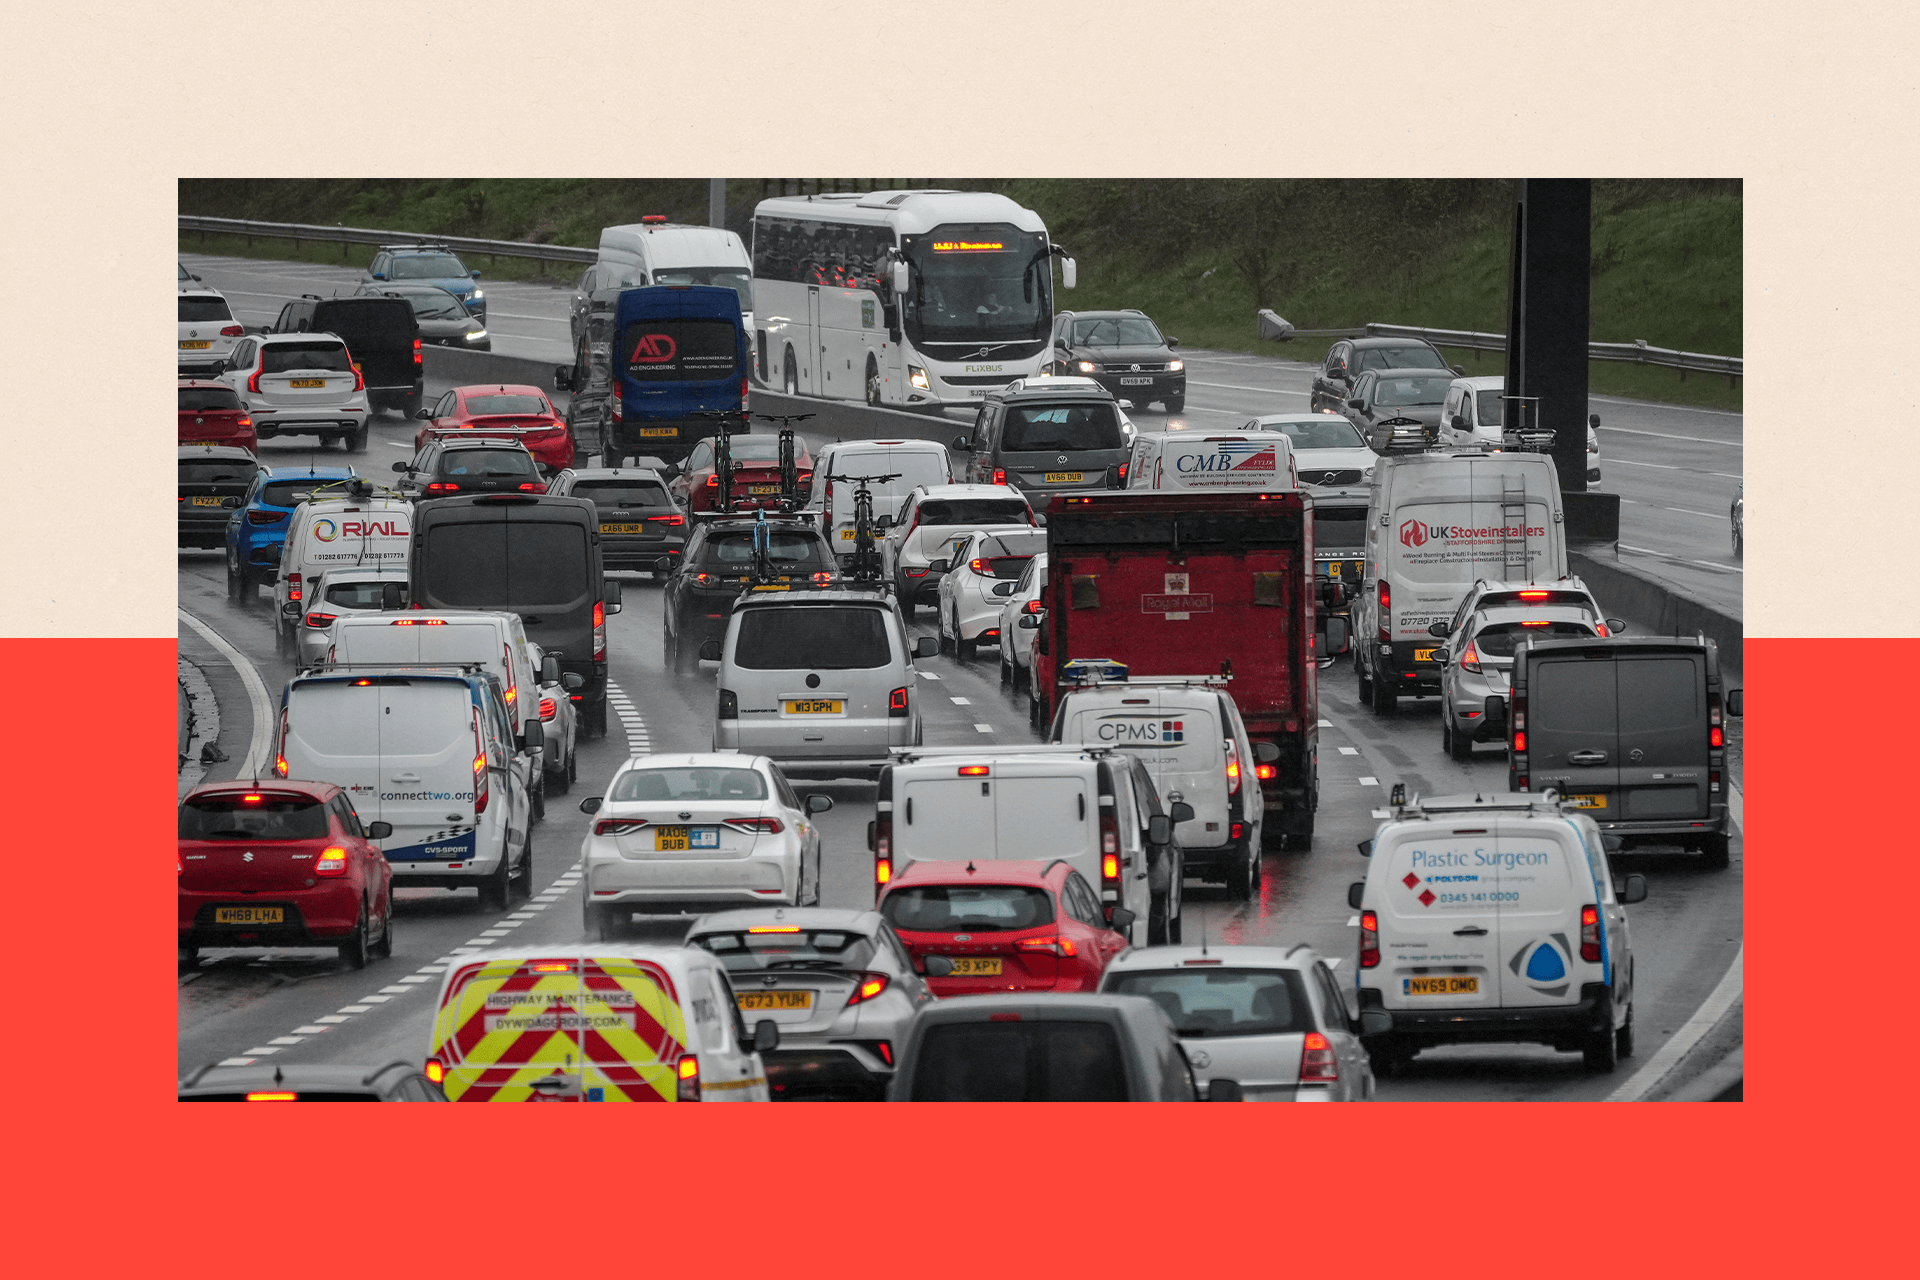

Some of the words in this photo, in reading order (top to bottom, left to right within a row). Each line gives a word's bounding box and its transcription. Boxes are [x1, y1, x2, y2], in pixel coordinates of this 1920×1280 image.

[1176, 454, 1232, 473] CMB
[1046, 473, 1066, 481] AV66
[1189, 479, 1267, 487] www.cmbengineering.co.uk
[342, 521, 409, 537] RWL
[602, 524, 622, 532] CA66
[1147, 597, 1180, 610] Royal
[1182, 597, 1208, 607] Mail
[1400, 617, 1429, 625] 07720
[795, 703, 810, 712] W13
[812, 702, 832, 711] GPH
[1098, 723, 1157, 740] CPMS
[381, 792, 474, 803] connecttwo.org
[662, 839, 684, 849] BUB
[425, 846, 468, 854] CVS-SPORT
[1412, 850, 1468, 868] Plastic
[1474, 848, 1548, 870] Surgeon
[1441, 893, 1468, 903] 0345
[1471, 893, 1487, 902] 141
[1490, 892, 1519, 901] 0000
[222, 909, 252, 920] WH68
[255, 910, 277, 920] LHA
[954, 960, 970, 972] 69
[974, 960, 998, 972] XPY
[1412, 979, 1446, 992] NV69
[487, 995, 542, 1005] HIGHWAY
[546, 993, 633, 1004] MAINTENANCE
[496, 1017, 622, 1030] DYWIDAGGROUP.COM
